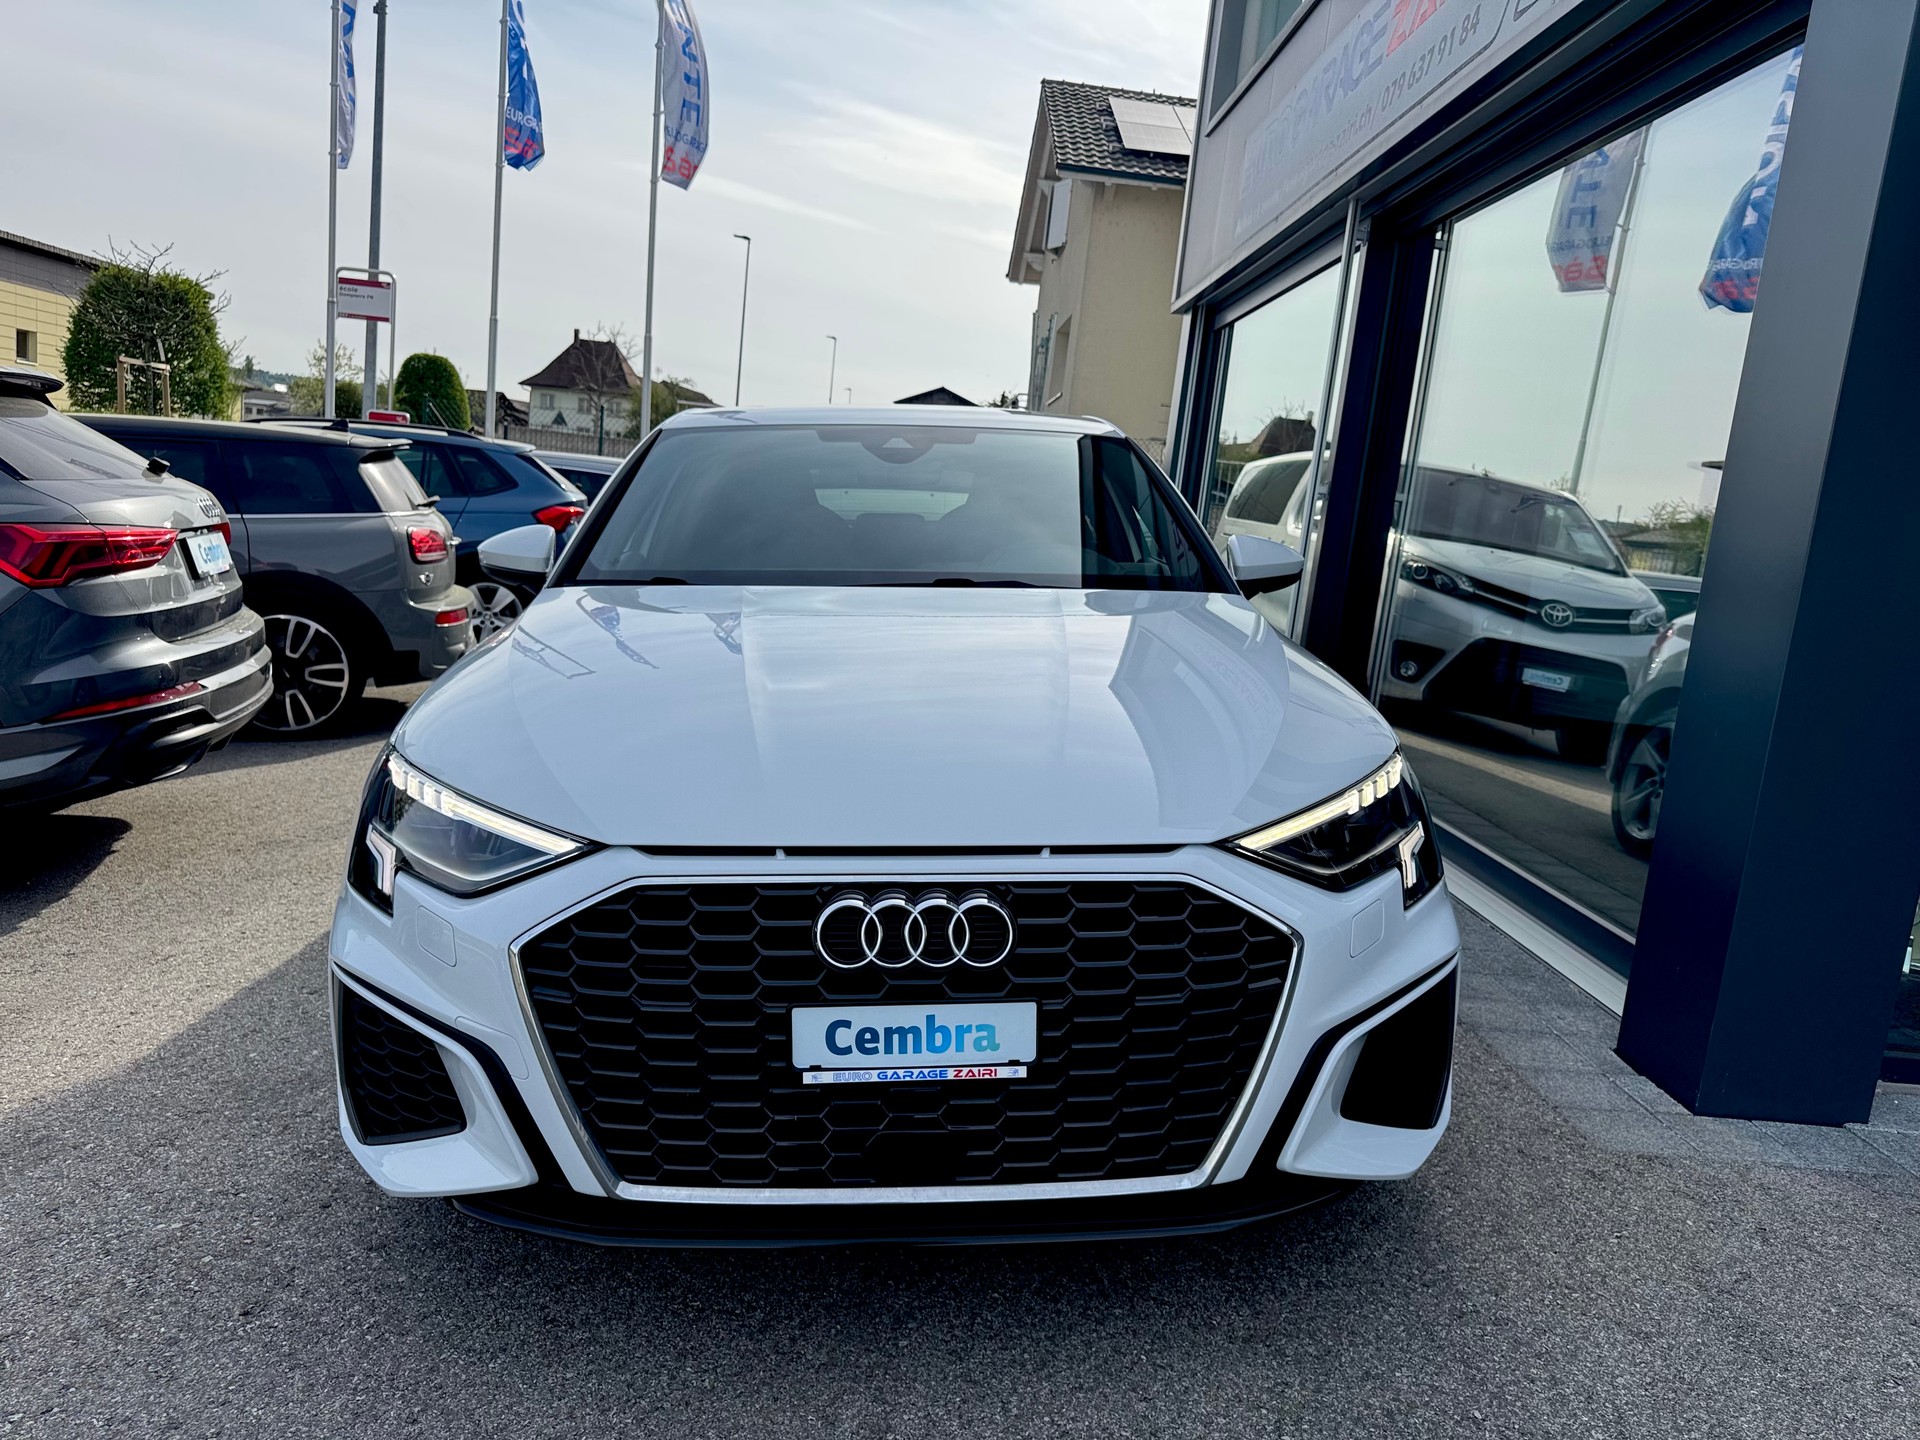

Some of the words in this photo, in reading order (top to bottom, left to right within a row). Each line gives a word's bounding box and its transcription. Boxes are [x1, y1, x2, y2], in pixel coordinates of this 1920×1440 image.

[1387, 0, 1446, 57] ZA
[1382, 71, 1407, 112] 079
[1408, 45, 1436, 90] 637
[1438, 26, 1456, 65] 91
[1459, 3, 1481, 46] 84
[825, 1014, 1001, 1056] Cembra
[832, 1071, 873, 1082] EURO
[877, 1069, 949, 1081] GARAGE
[953, 1068, 998, 1079] ZAIRI
